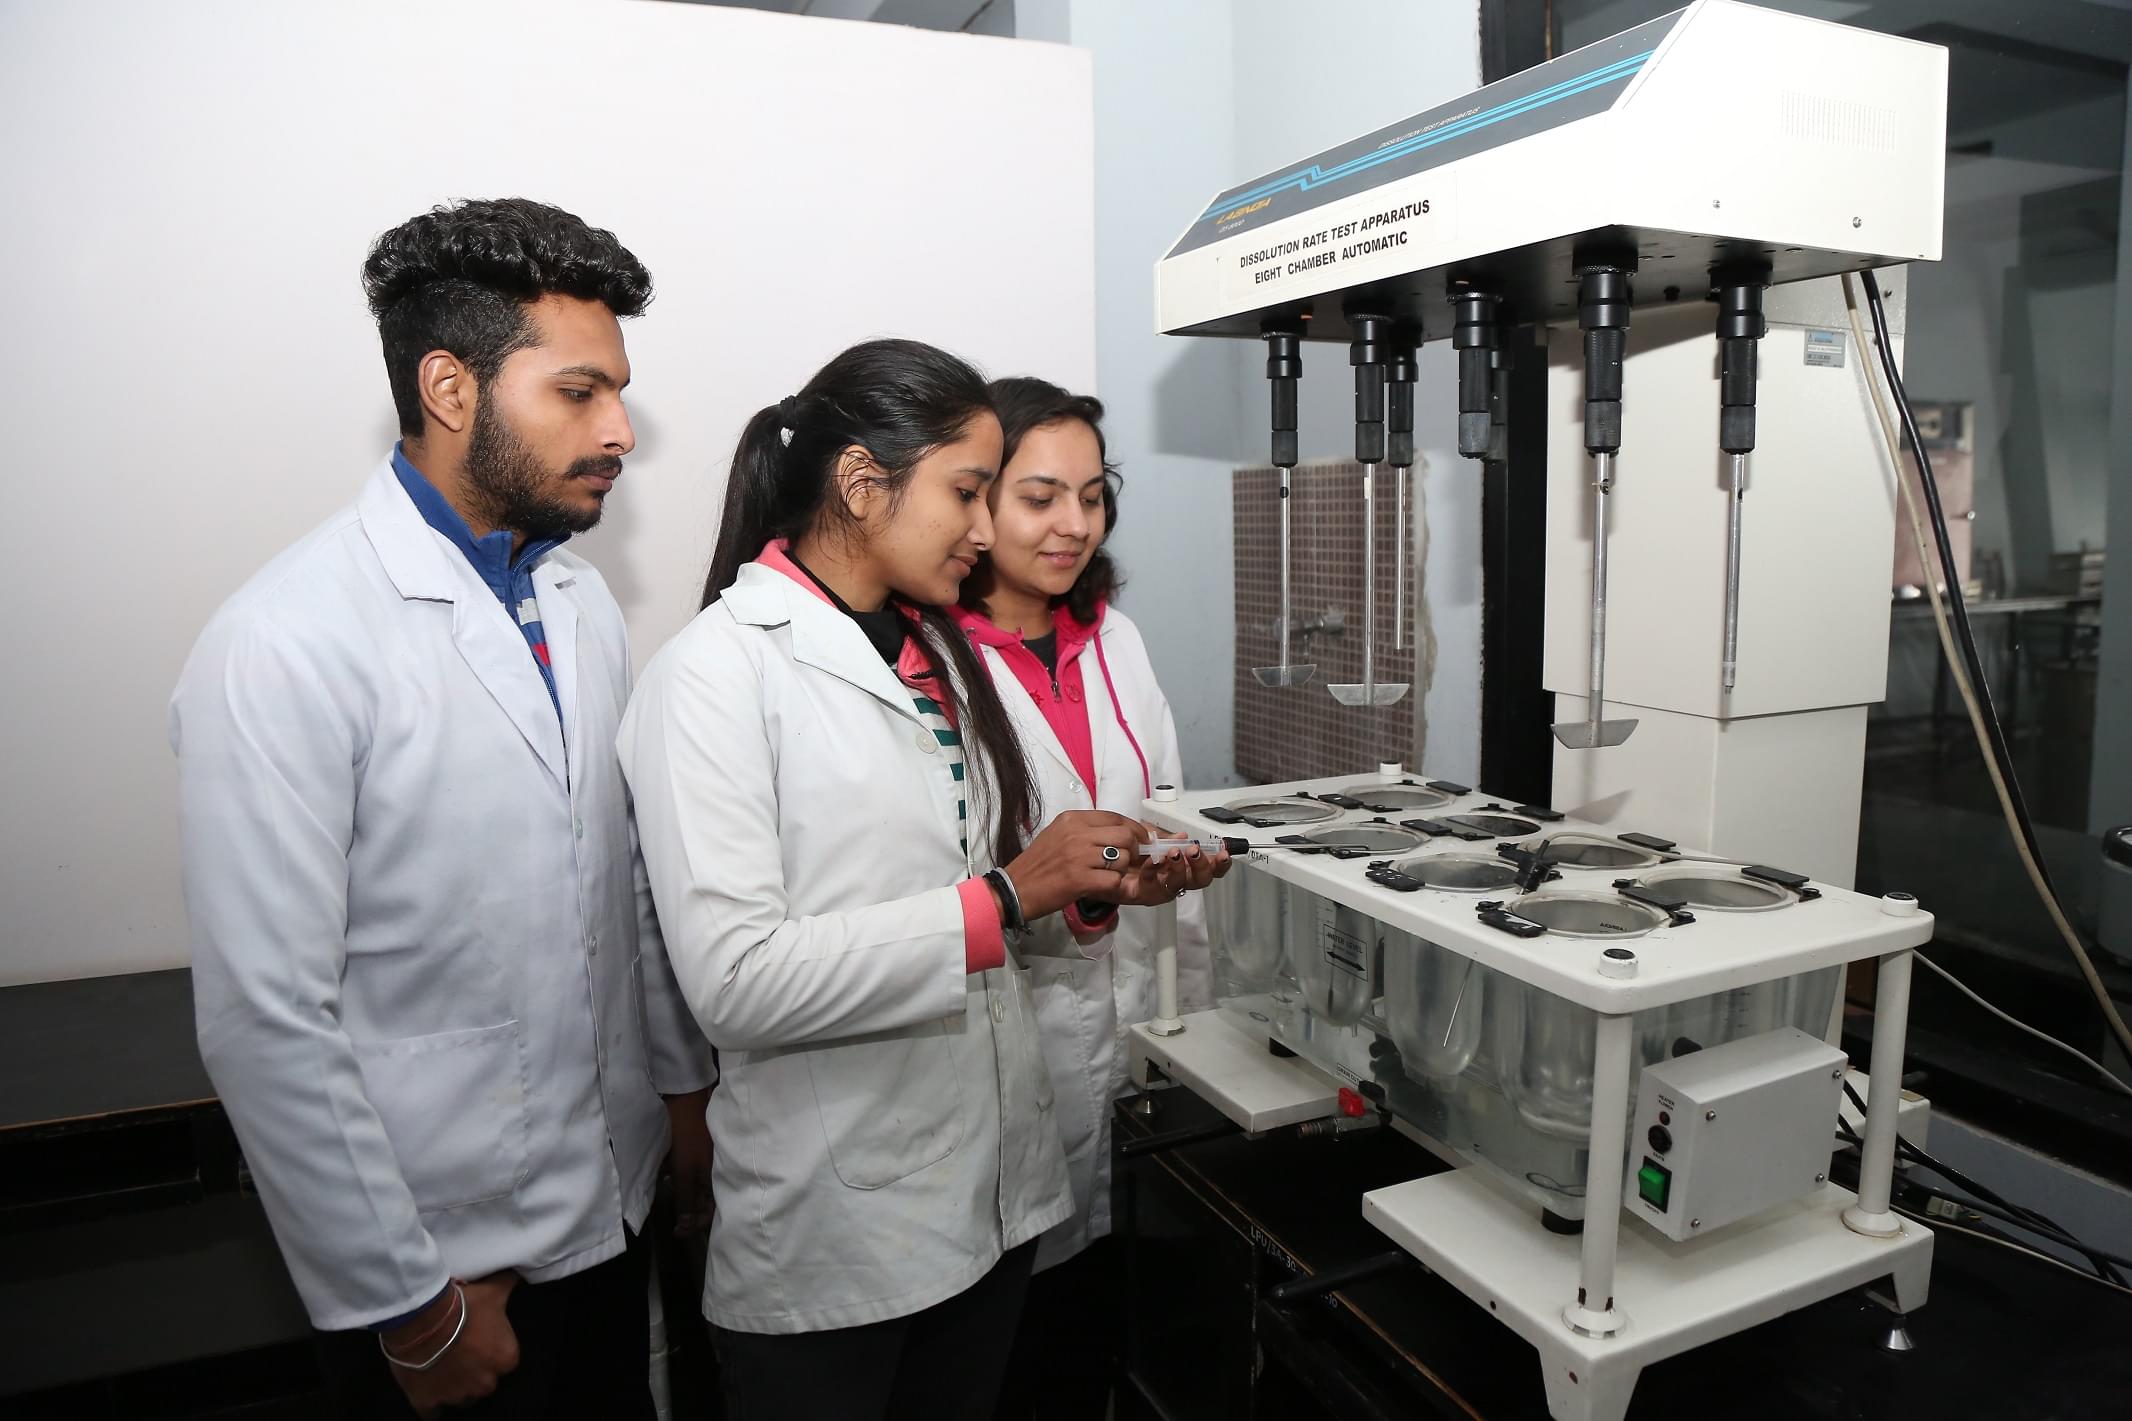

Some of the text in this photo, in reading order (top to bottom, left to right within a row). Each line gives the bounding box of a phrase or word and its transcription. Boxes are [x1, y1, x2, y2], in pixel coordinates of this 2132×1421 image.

[1240, 199, 1430, 268] DISSOLUTION RATE TEST APPARATUS
[1255, 230, 1408, 284] EIGHT CHAMBER AUTOMATIC
